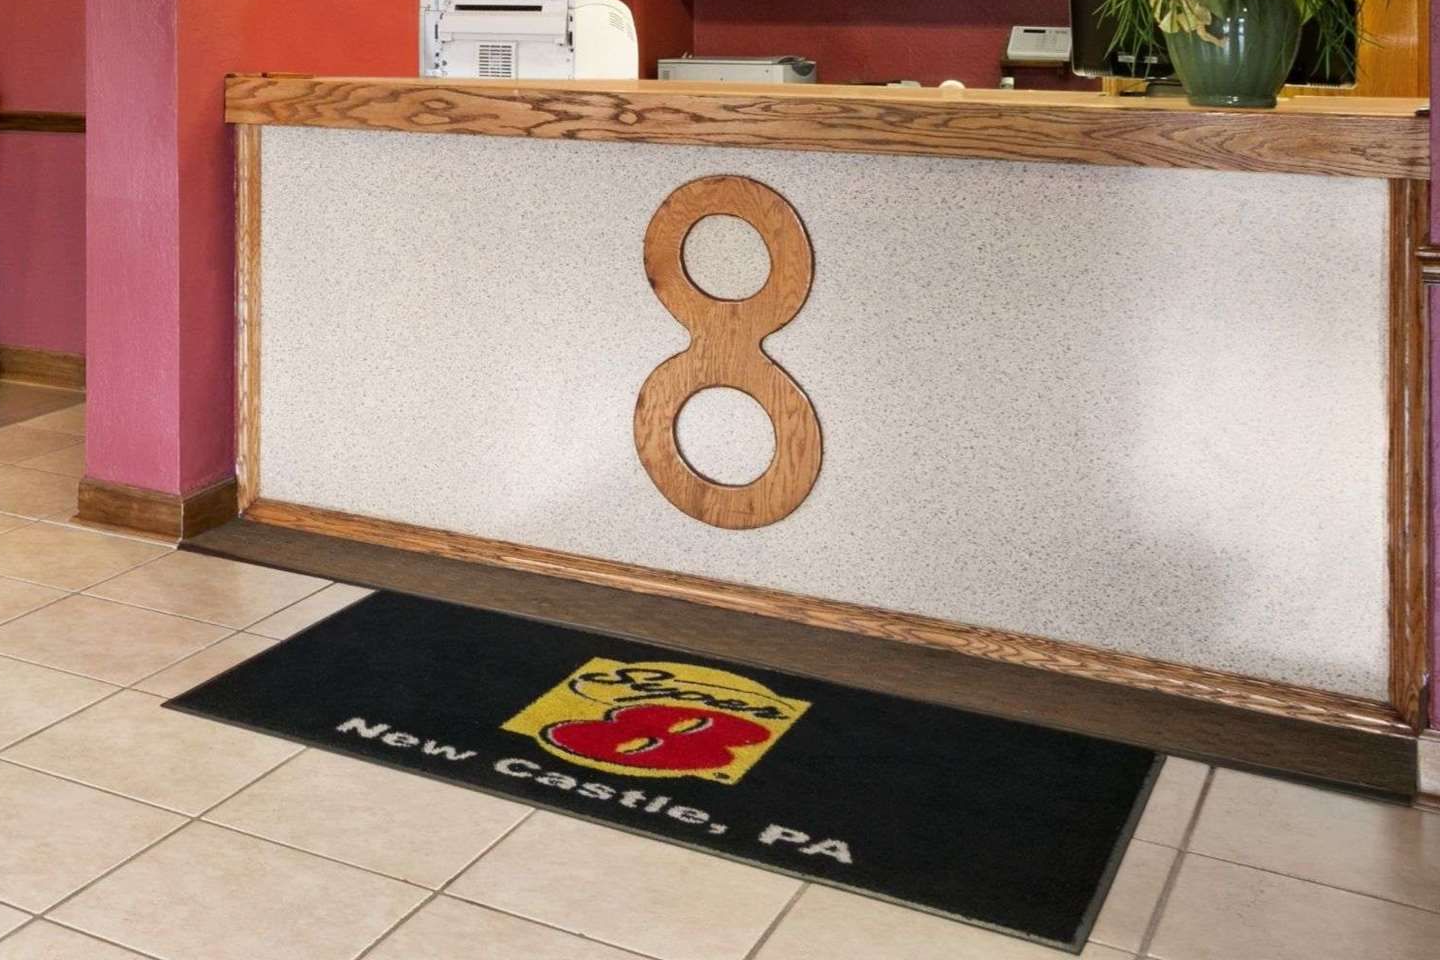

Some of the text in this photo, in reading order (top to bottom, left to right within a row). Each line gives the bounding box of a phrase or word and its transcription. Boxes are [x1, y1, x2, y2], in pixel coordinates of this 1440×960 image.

[633, 174, 823, 530] 8
[537, 702, 772, 772] 8
[568, 667, 790, 720] Super
[335, 717, 854, 865] New Castle, PA
